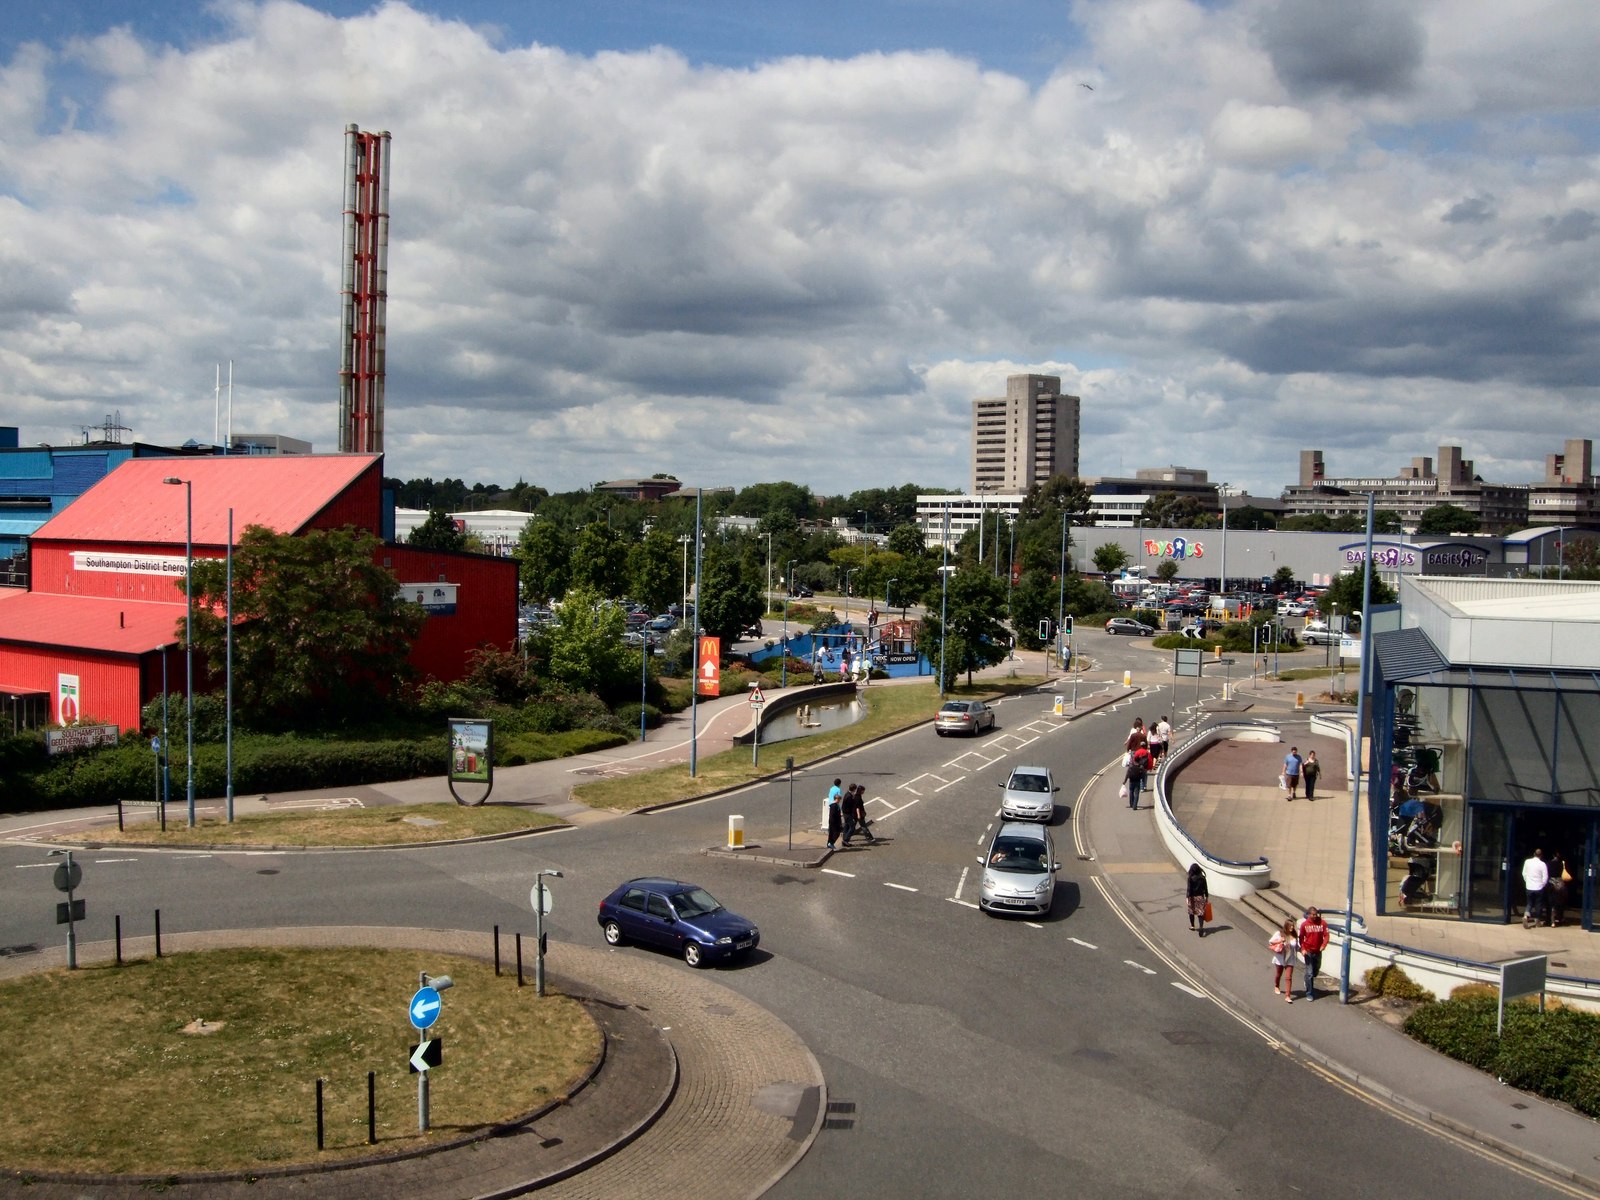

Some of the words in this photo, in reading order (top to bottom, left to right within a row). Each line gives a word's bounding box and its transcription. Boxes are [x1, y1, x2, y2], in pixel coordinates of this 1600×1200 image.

[86, 557, 132, 571] Southampton
[134, 560, 160, 571] District
[162, 561, 188, 576] Energy
[61, 727, 106, 738] SOUTHAMPTON
